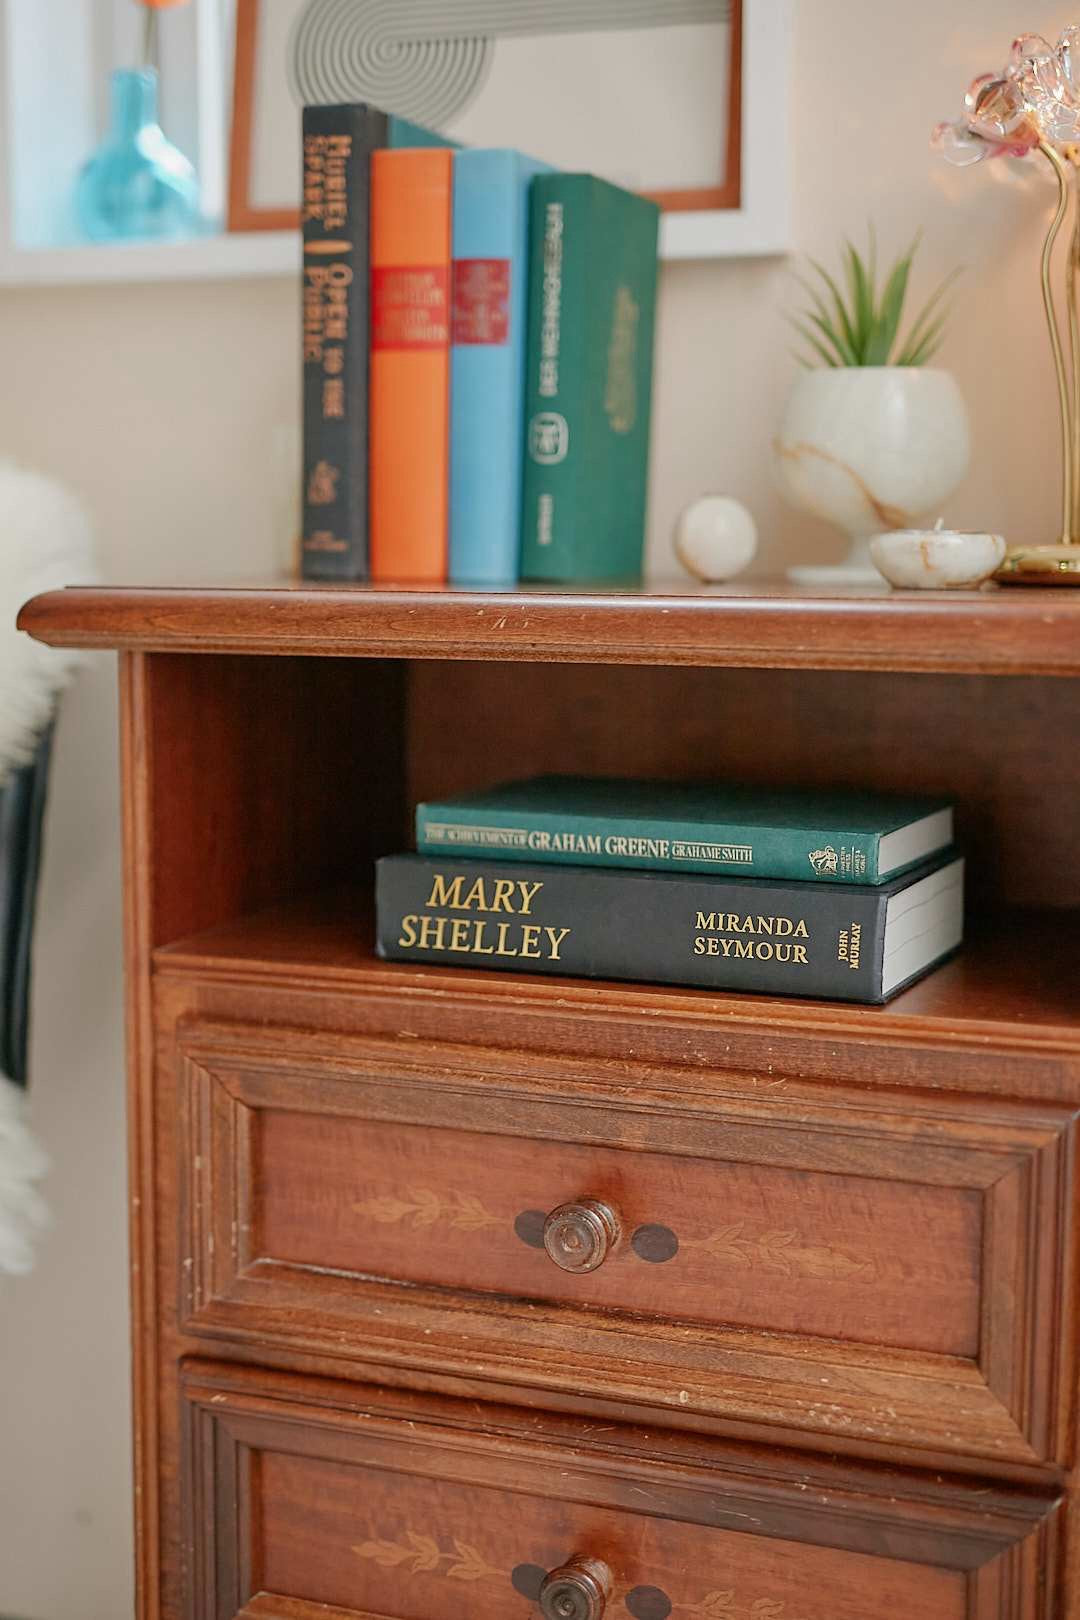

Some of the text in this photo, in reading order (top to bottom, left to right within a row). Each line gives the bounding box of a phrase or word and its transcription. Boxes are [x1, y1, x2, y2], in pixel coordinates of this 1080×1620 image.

[528, 830, 601, 854] GRAHAM
[605, 836, 670, 860] GREENE
[672, 844, 721, 860] GRAHAME
[722, 847, 753, 862] SMITH
[425, 874, 544, 915] MARY
[398, 915, 572, 960] SHELLEY
[695, 911, 810, 938] MIRANDA
[694, 936, 809, 964] SEYMOUR
[838, 930, 849, 962] JOHN
[849, 923, 861, 969] MURRAY
